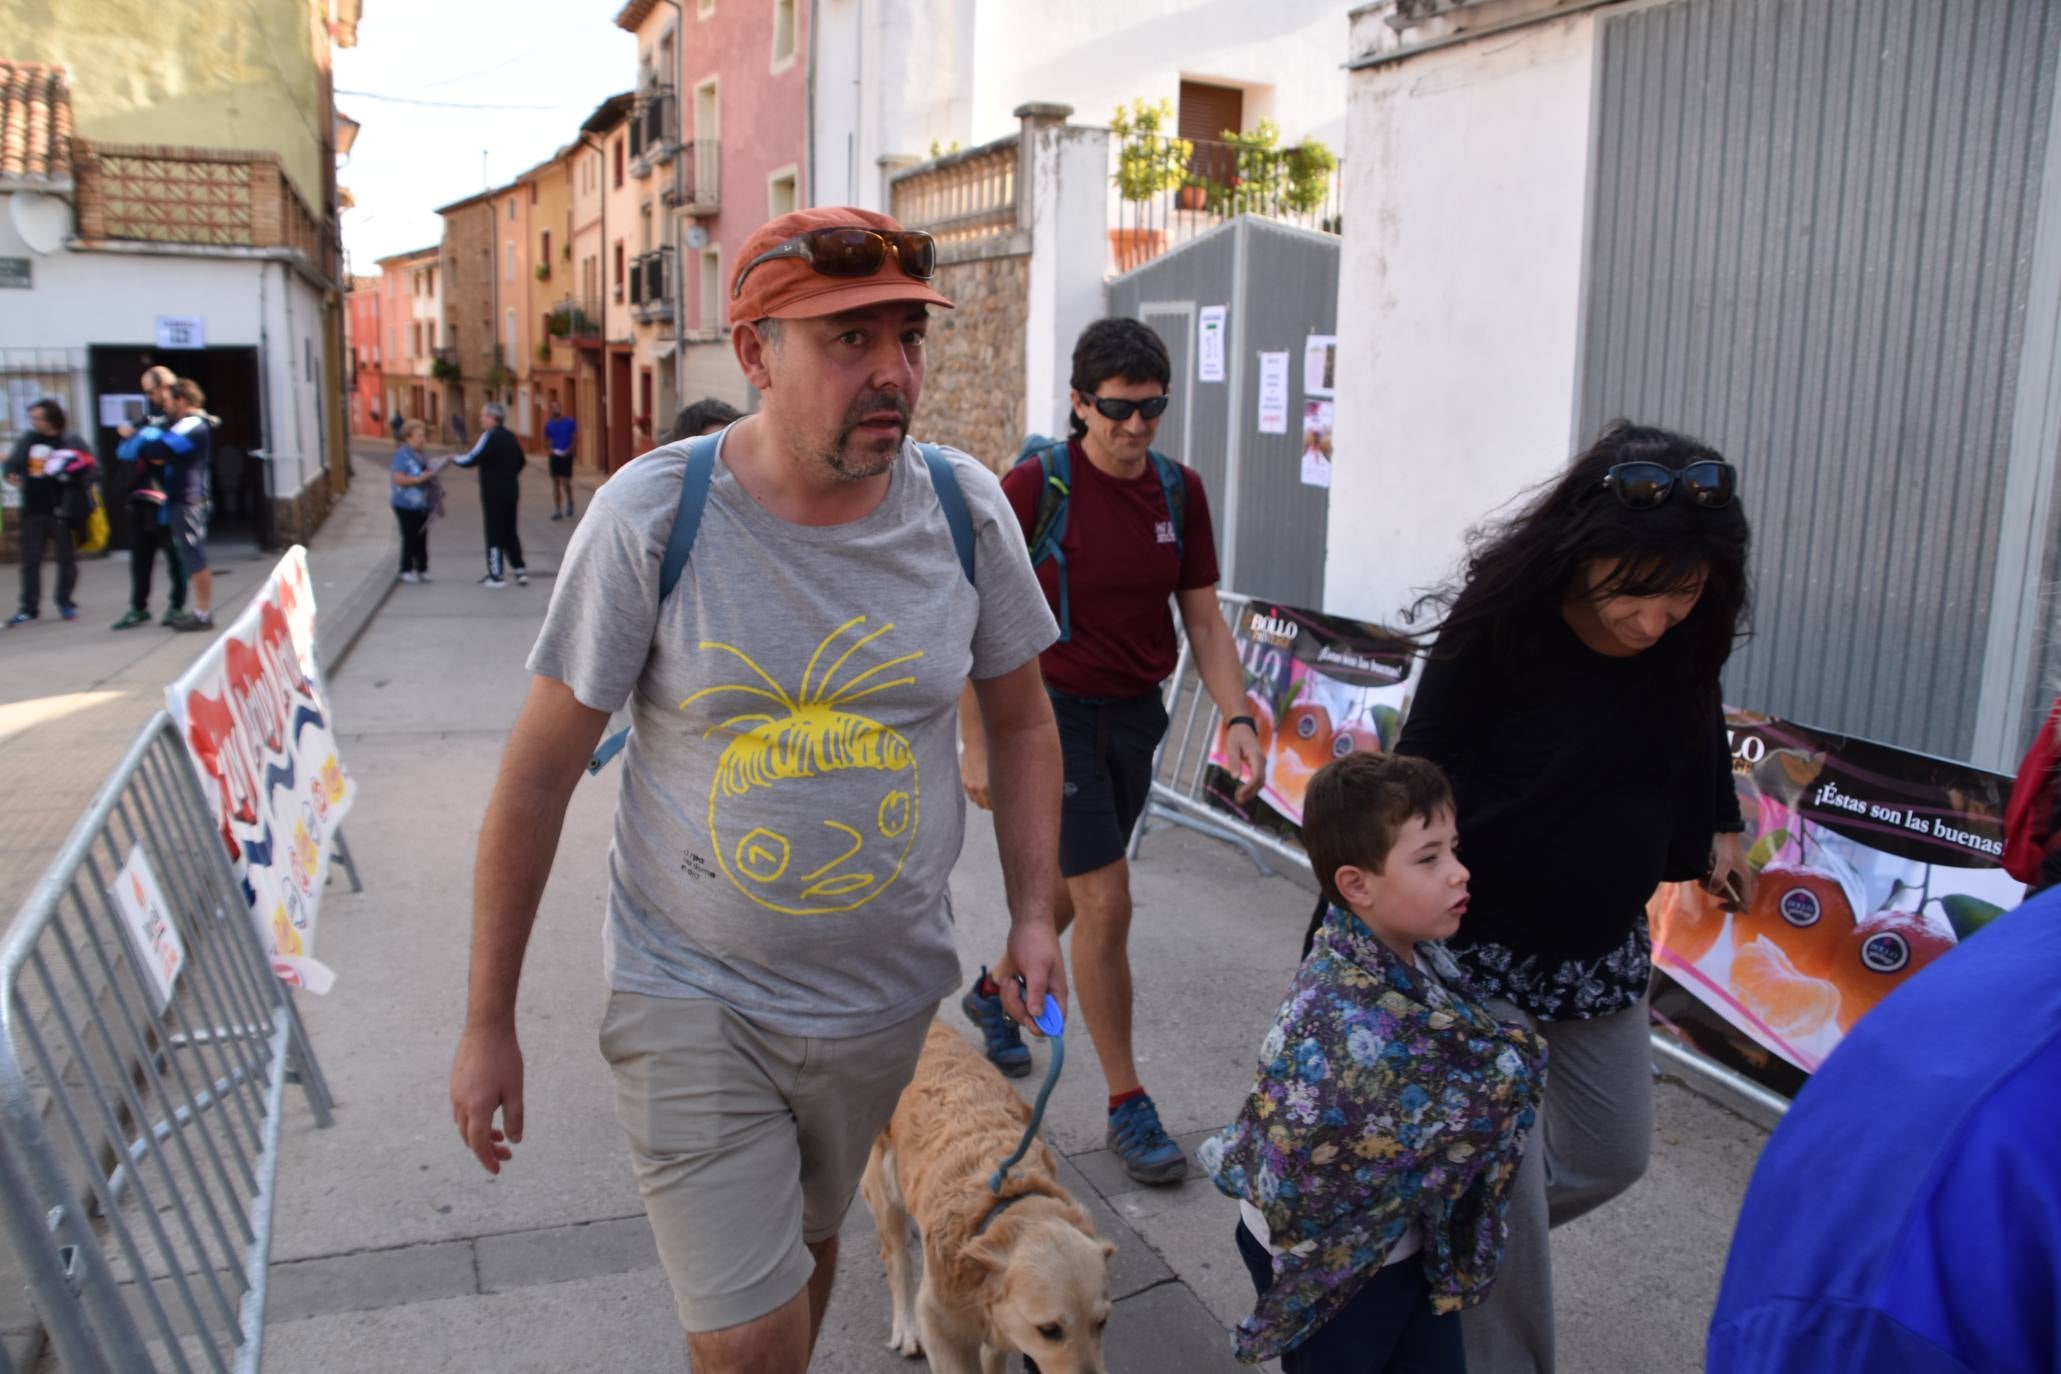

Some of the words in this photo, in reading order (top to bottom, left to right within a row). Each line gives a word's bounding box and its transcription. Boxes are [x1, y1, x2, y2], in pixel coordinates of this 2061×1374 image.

[1251, 613, 1298, 640] BOLLO
[1814, 781, 1868, 815] ¡Éstas
[1870, 803, 1902, 826] son
[1904, 810, 1930, 834] las
